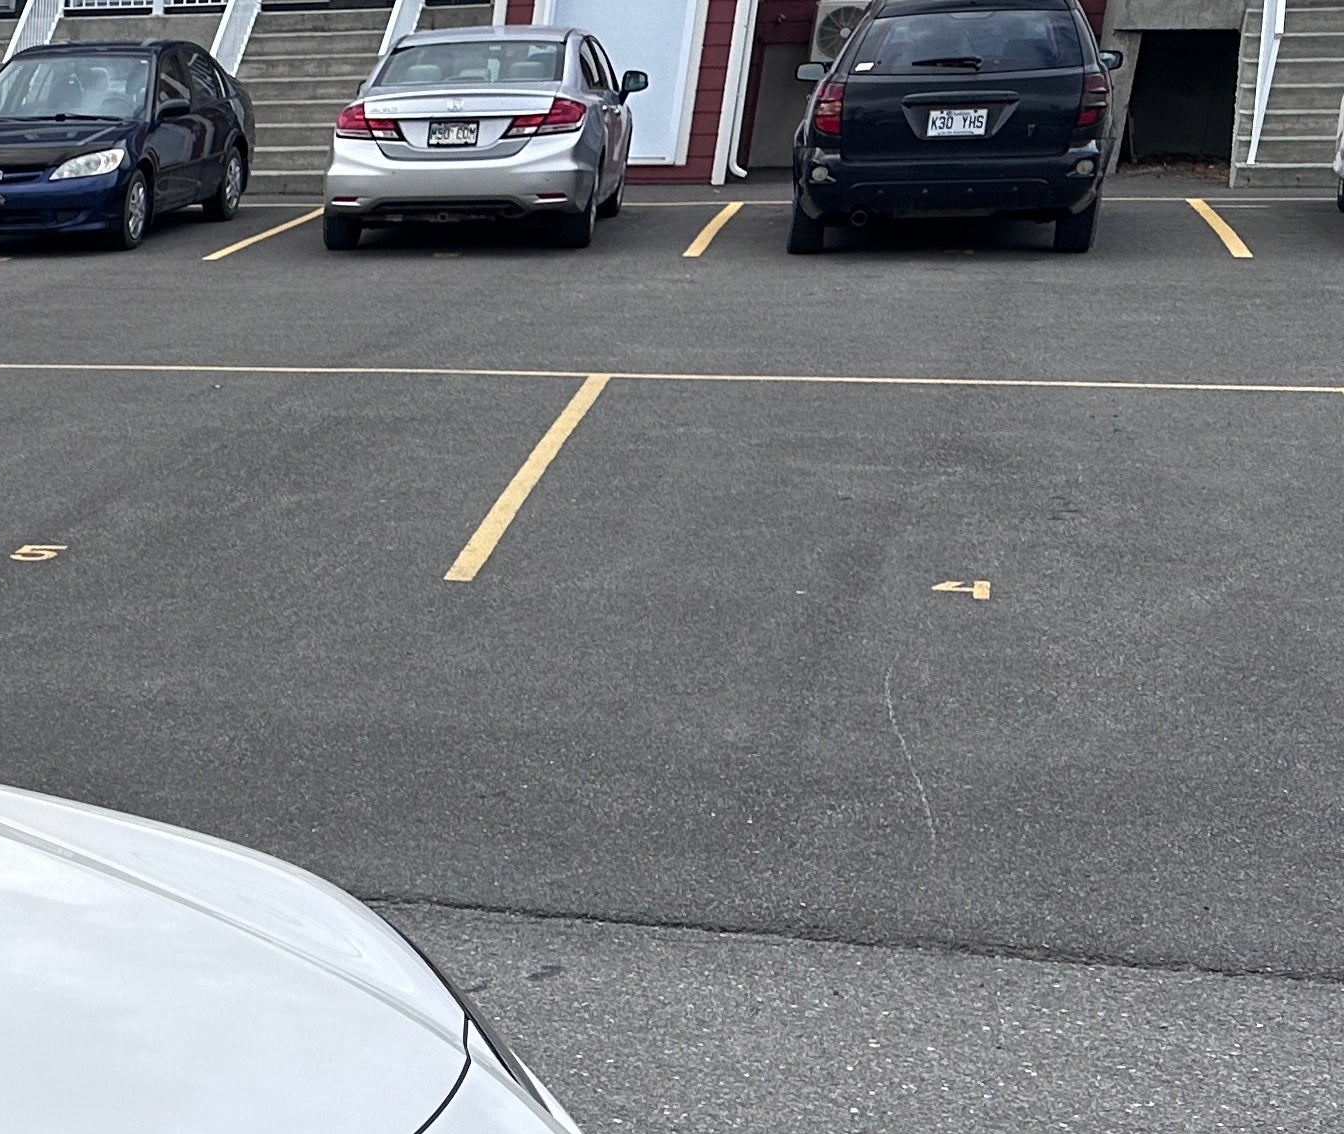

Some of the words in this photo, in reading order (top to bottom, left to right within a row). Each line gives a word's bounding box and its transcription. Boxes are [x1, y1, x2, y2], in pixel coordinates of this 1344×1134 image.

[931, 116, 953, 130] K30
[962, 115, 985, 129] YHS
[9, 544, 69, 561] 5
[931, 580, 991, 600] 4
